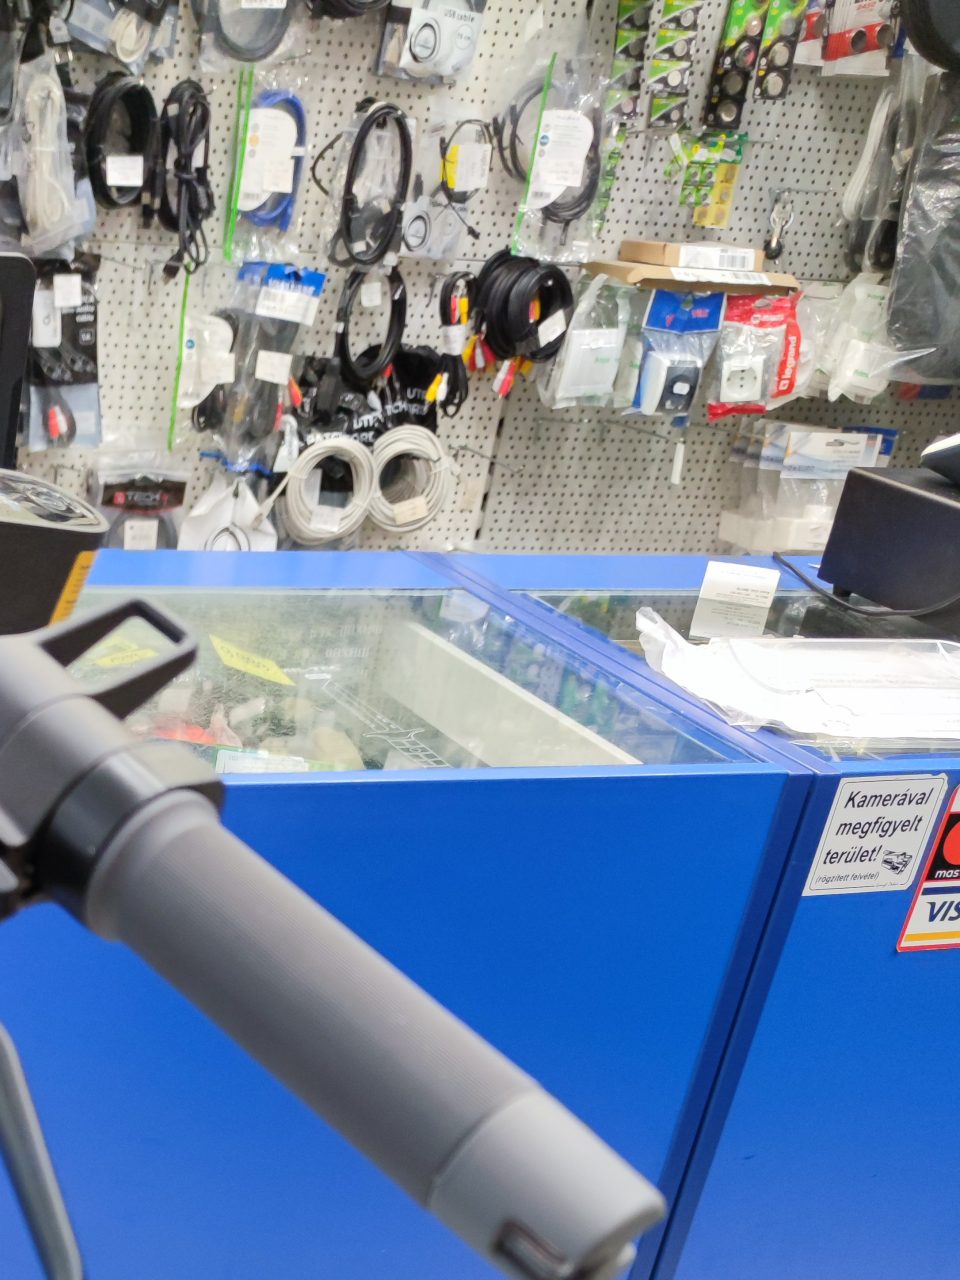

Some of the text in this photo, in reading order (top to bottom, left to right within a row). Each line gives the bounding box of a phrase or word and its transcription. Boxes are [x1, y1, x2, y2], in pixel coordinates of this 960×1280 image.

[782, 336, 797, 379] legrand
[844, 788, 934, 809] Kamerával
[835, 815, 923, 839] megfigyelt
[823, 845, 883, 864] terület!
